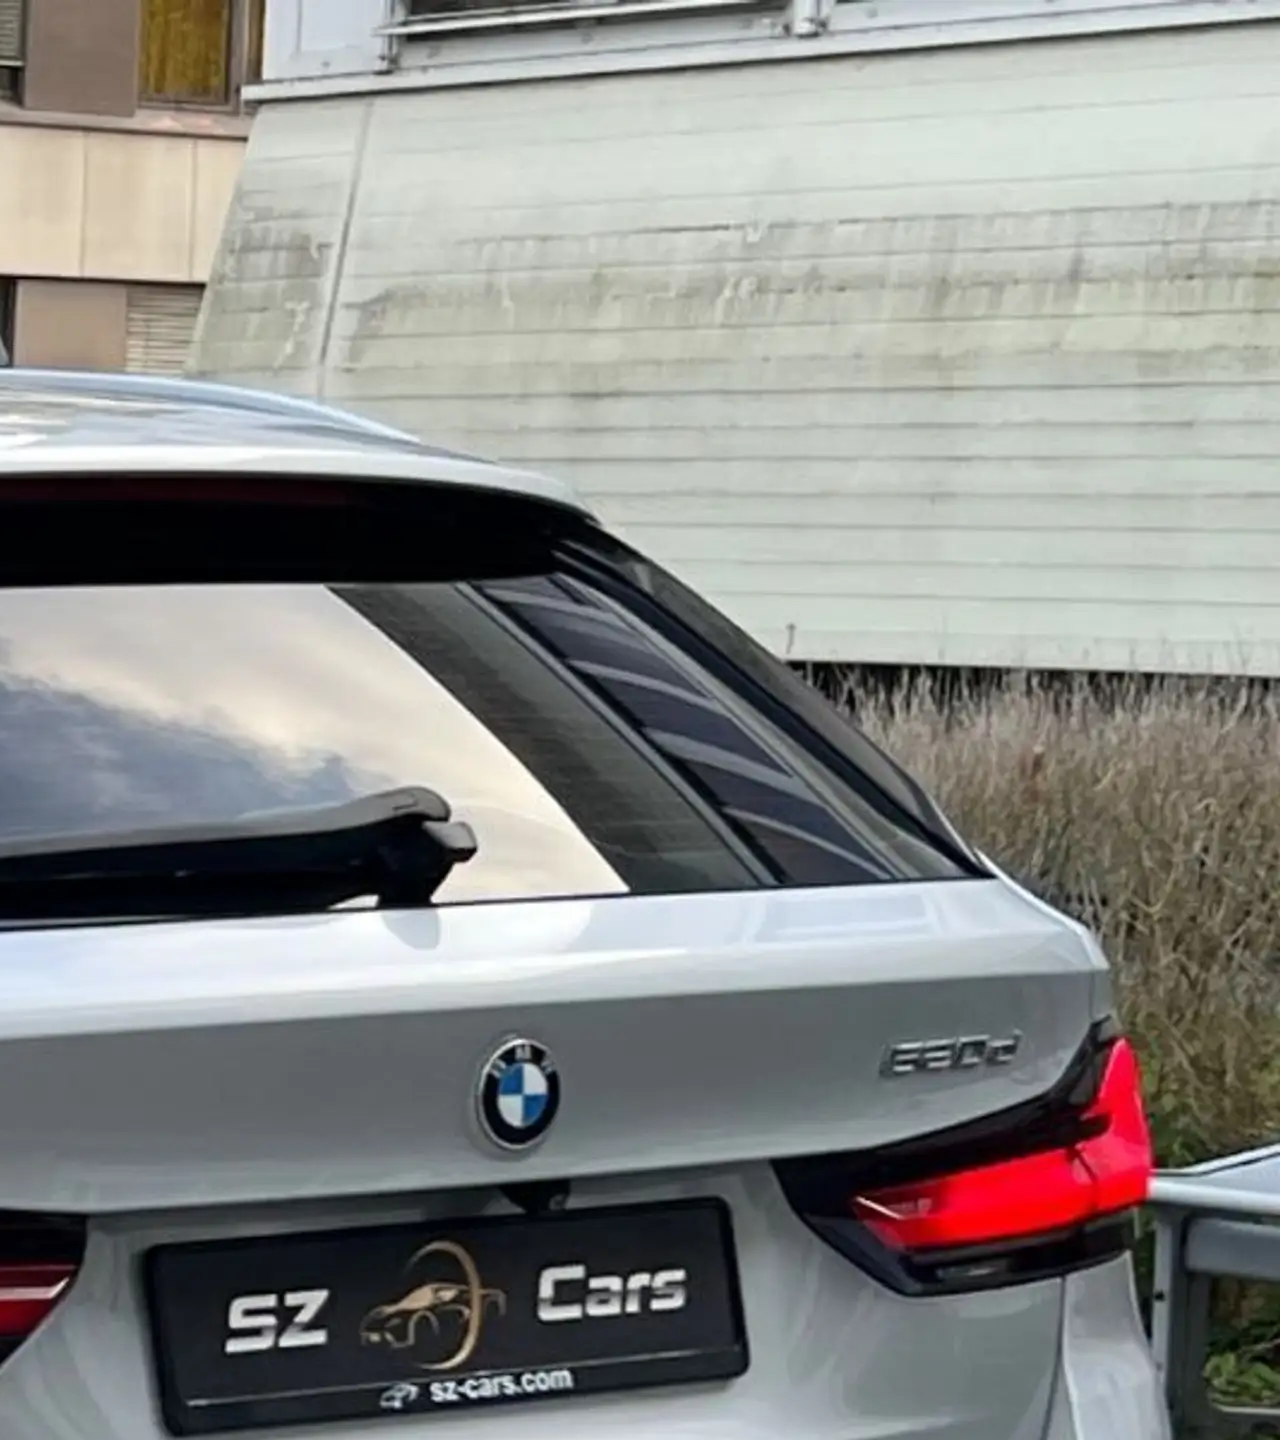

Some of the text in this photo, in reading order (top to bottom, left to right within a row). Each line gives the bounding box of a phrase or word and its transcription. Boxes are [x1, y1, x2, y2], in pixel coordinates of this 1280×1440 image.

[224, 1264, 687, 1354] SZ Cars
[429, 1367, 574, 1403] sz-cars.com
